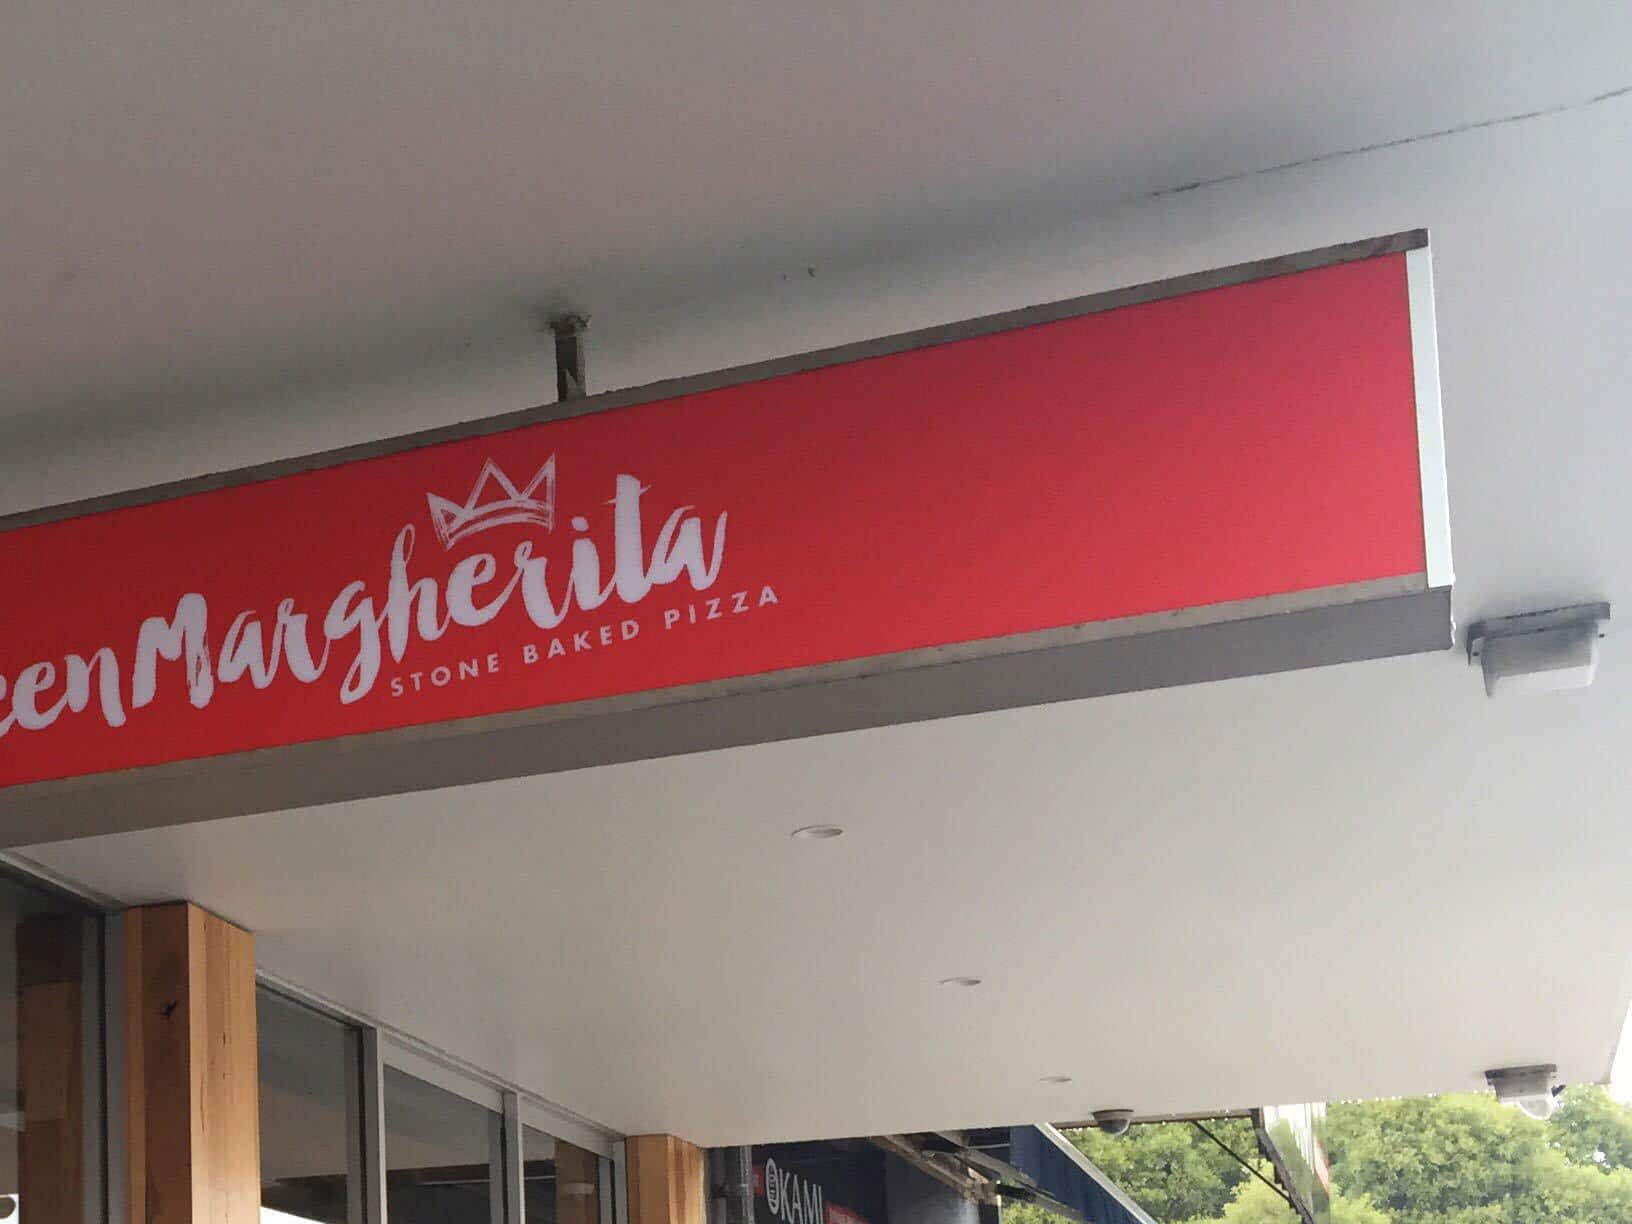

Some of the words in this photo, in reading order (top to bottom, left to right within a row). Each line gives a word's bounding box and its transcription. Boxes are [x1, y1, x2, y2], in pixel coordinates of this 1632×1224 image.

[390, 652, 500, 697] STONE
[522, 619, 641, 665] BAKED
[663, 585, 779, 630] PIZZA
